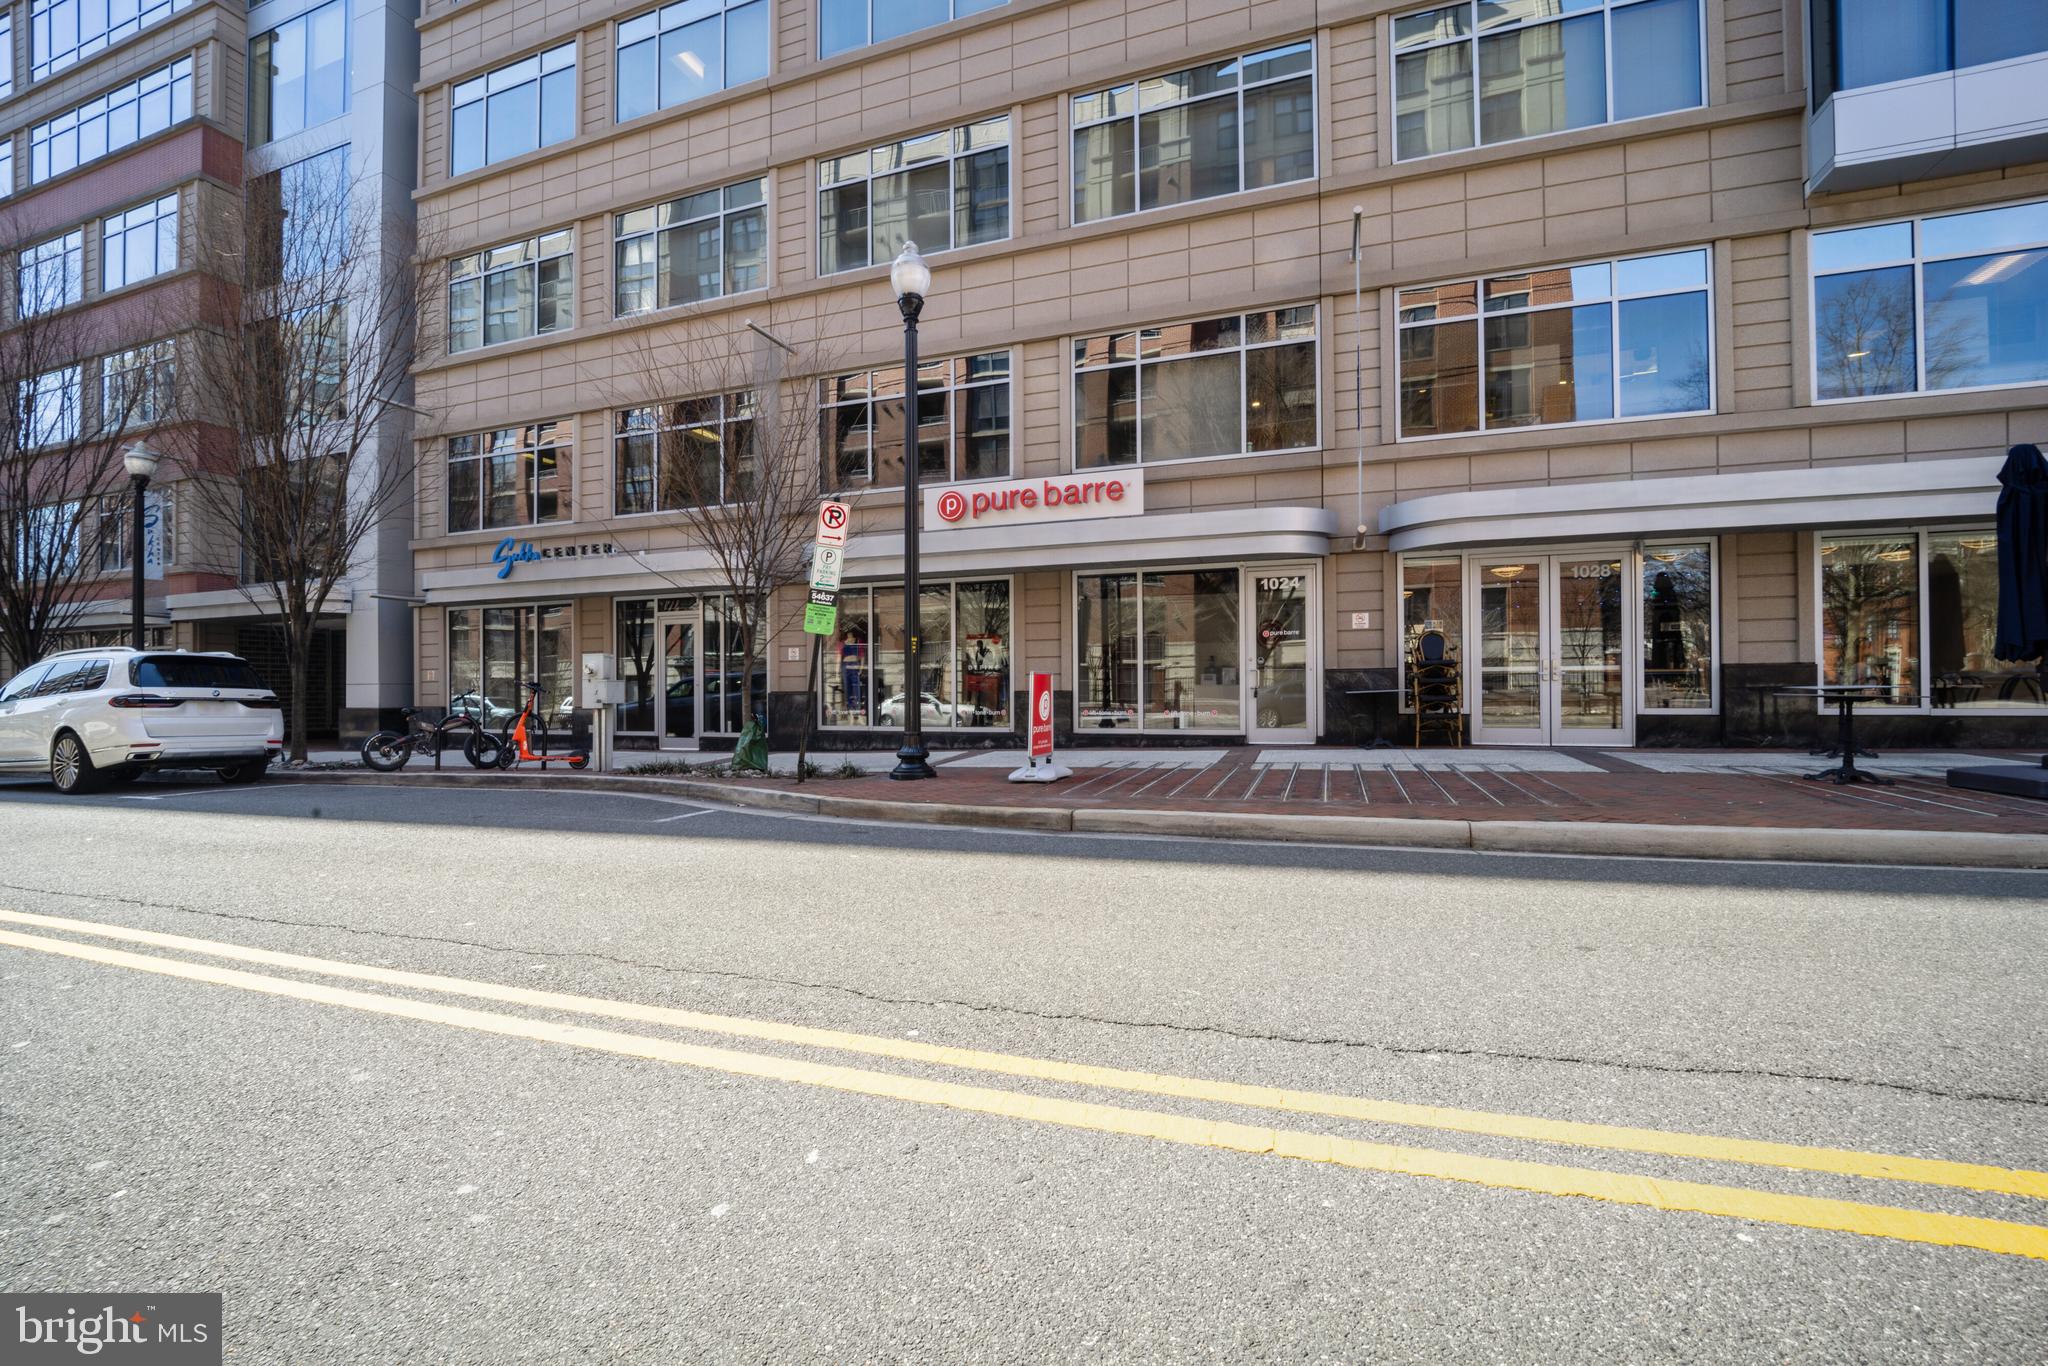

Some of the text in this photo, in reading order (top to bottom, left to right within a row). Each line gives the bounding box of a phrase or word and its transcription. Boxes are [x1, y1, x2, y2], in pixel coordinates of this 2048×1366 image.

[972, 488, 1038, 519] pure
[1044, 480, 1124, 506] barre
[542, 543, 613, 559] CENTER
[1571, 564, 1611, 578] 1028
[1261, 577, 1300, 590] 1024
